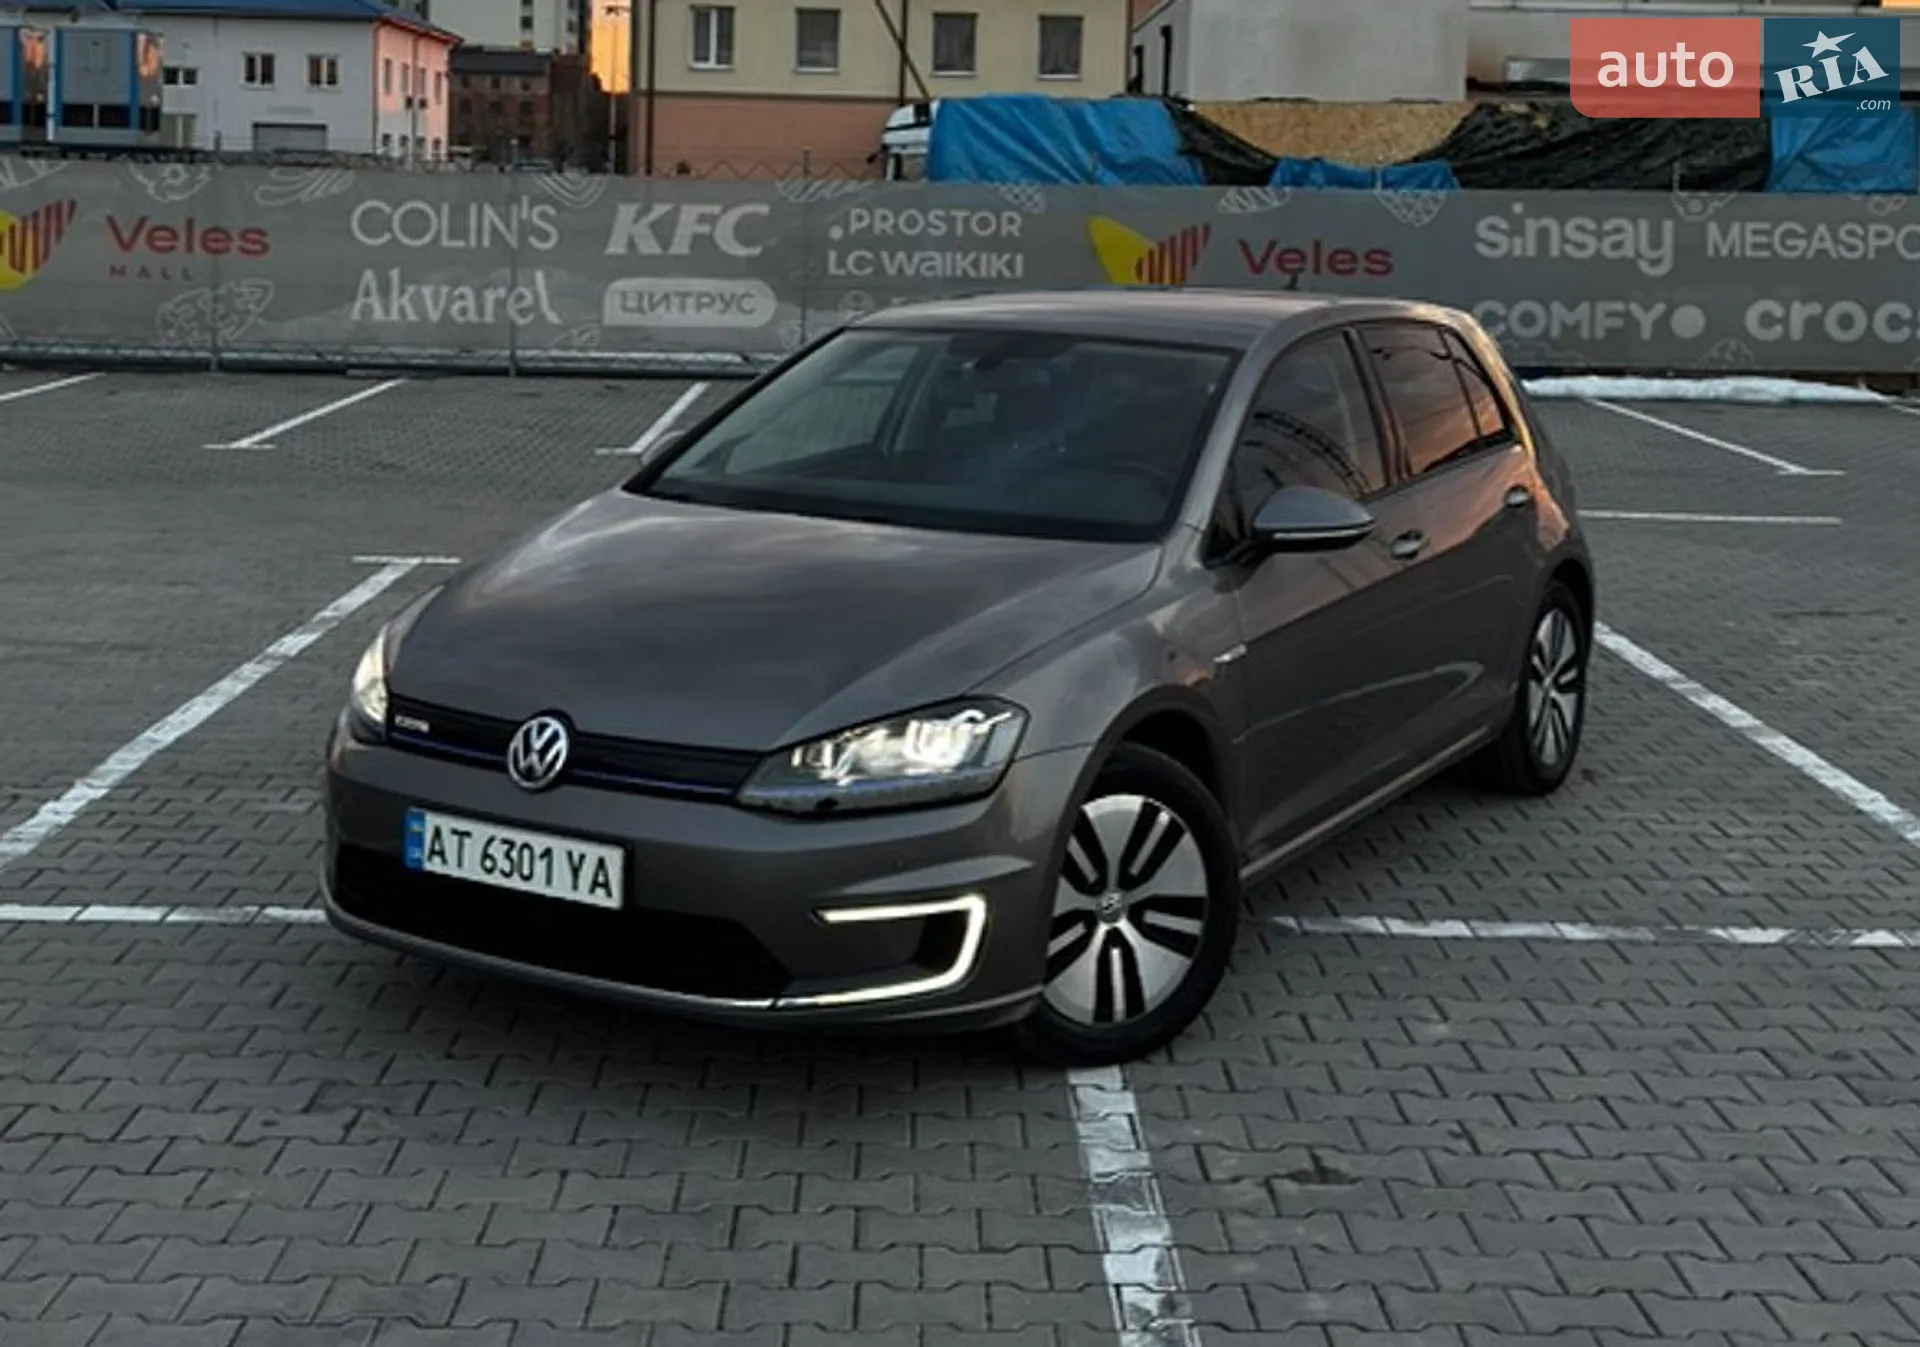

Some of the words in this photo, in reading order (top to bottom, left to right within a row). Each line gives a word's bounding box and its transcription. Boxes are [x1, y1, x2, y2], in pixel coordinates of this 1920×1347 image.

[105, 215, 270, 258] Veles
[351, 195, 559, 250] COLIN'S
[604, 203, 771, 257] KFC
[1474, 202, 1675, 278] sinsay
[1706, 221, 1920, 260] MEGASPO
[109, 265, 193, 280] MALL
[827, 249, 874, 276] LC
[1238, 239, 1394, 276] Veles
[351, 267, 562, 325] Akvarel
[620, 290, 756, 315] ЦИТРУС
[1473, 299, 1667, 341] COMFY
[1745, 299, 1920, 343] croc
[427, 824, 472, 869] AT
[479, 834, 554, 887] 6301
[566, 849, 613, 899] YA
